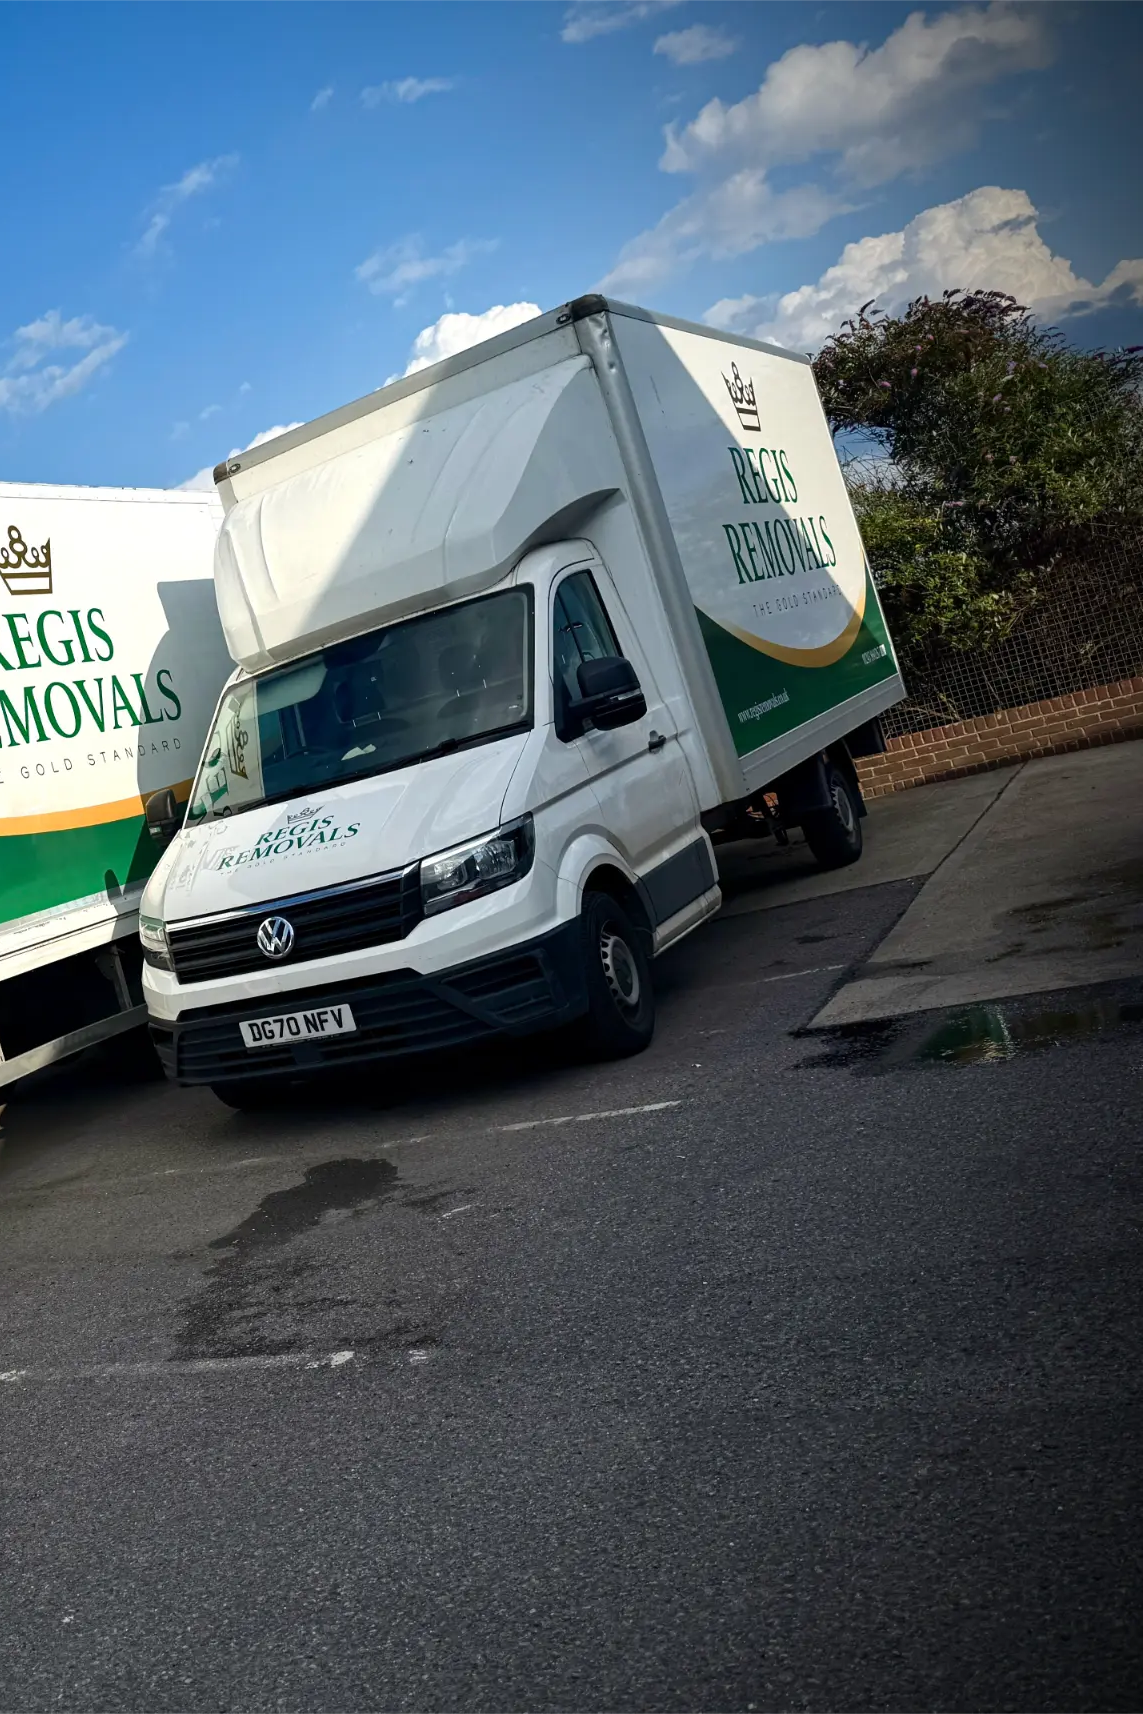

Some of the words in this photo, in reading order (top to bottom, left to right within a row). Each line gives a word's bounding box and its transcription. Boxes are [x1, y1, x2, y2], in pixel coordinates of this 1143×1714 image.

[728, 447, 798, 504] REGIS
[722, 515, 836, 585] REMOVALS
[752, 602, 772, 617] THE
[776, 594, 799, 612] GOLD
[20, 757, 74, 779] GOLD
[87, 738, 182, 766] STANDARD
[217, 823, 361, 871] REMOVALS
[255, 815, 335, 846] REGIS
[248, 1016, 301, 1042] DG70
[303, 1008, 344, 1034] NFV
